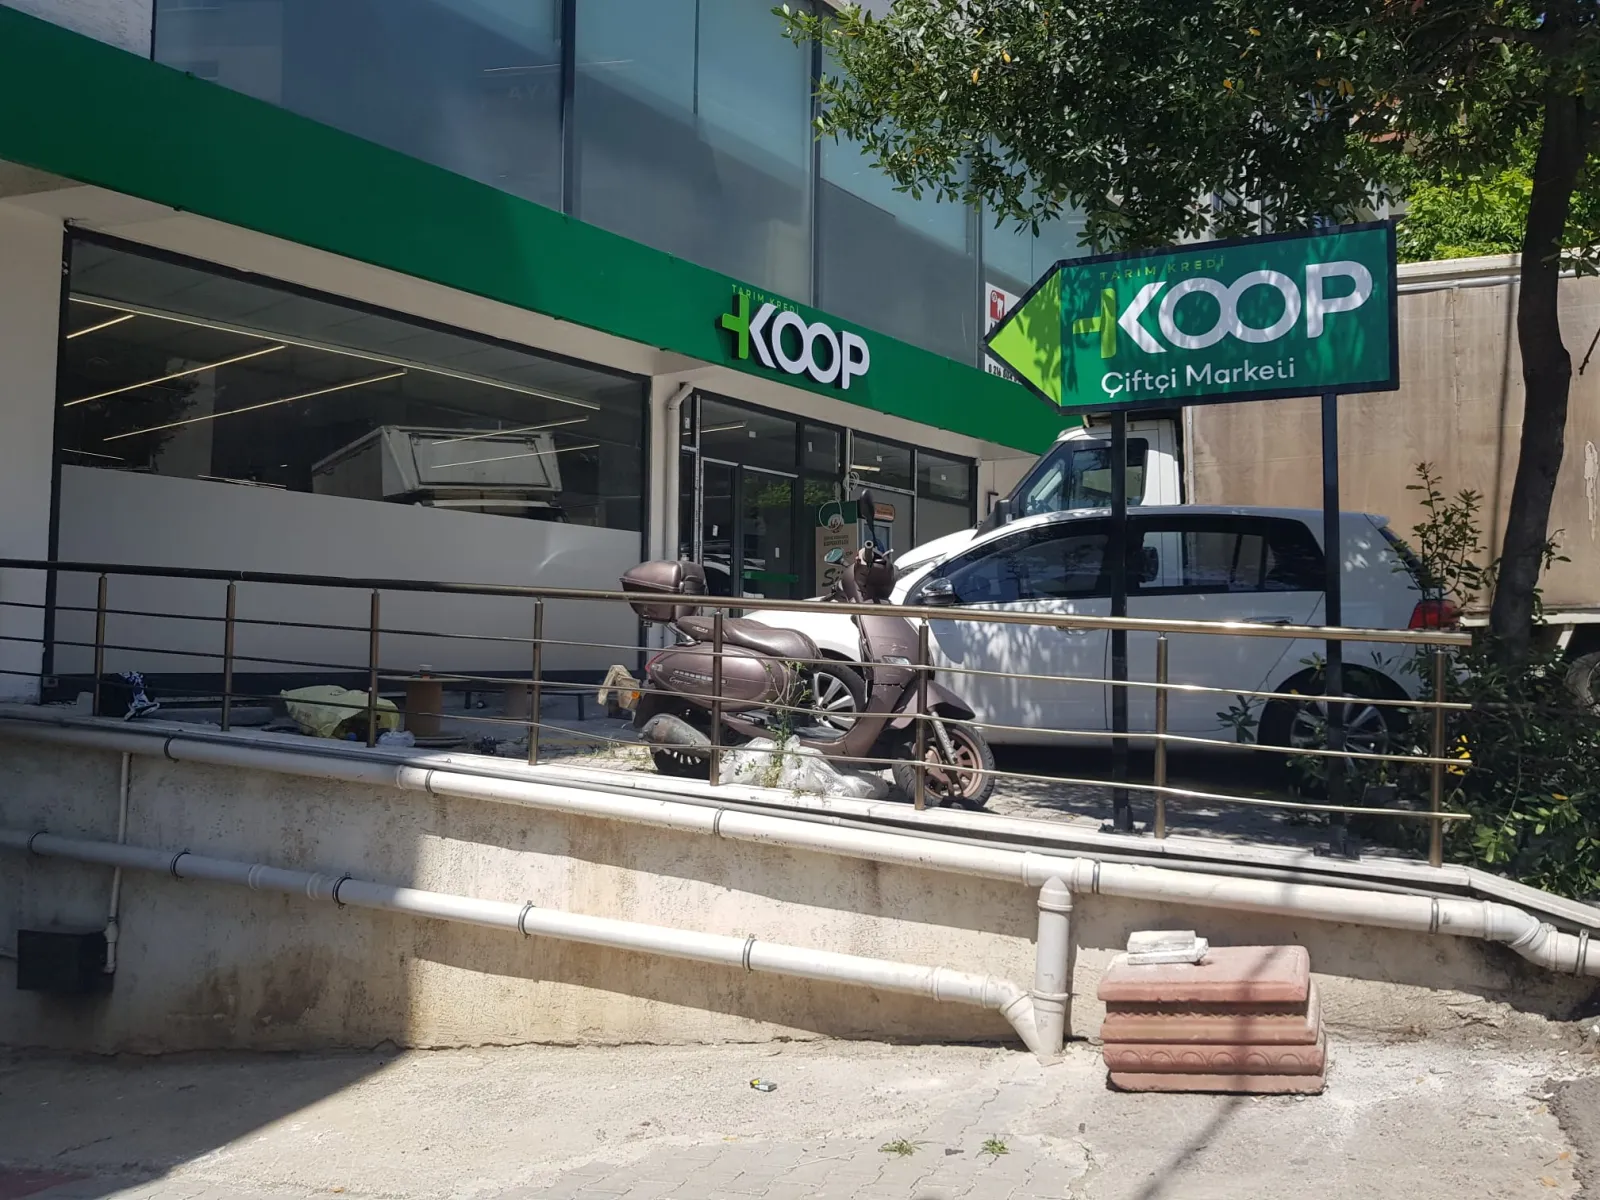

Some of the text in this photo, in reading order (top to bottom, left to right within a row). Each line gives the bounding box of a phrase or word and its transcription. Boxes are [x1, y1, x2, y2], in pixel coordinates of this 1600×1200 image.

[1099, 266, 1157, 281] TARIM
[731, 284, 765, 304] TARIM
[1100, 260, 1373, 359] KOOP
[740, 294, 870, 390] KOOP
[1101, 367, 1177, 399] Çiftçi
